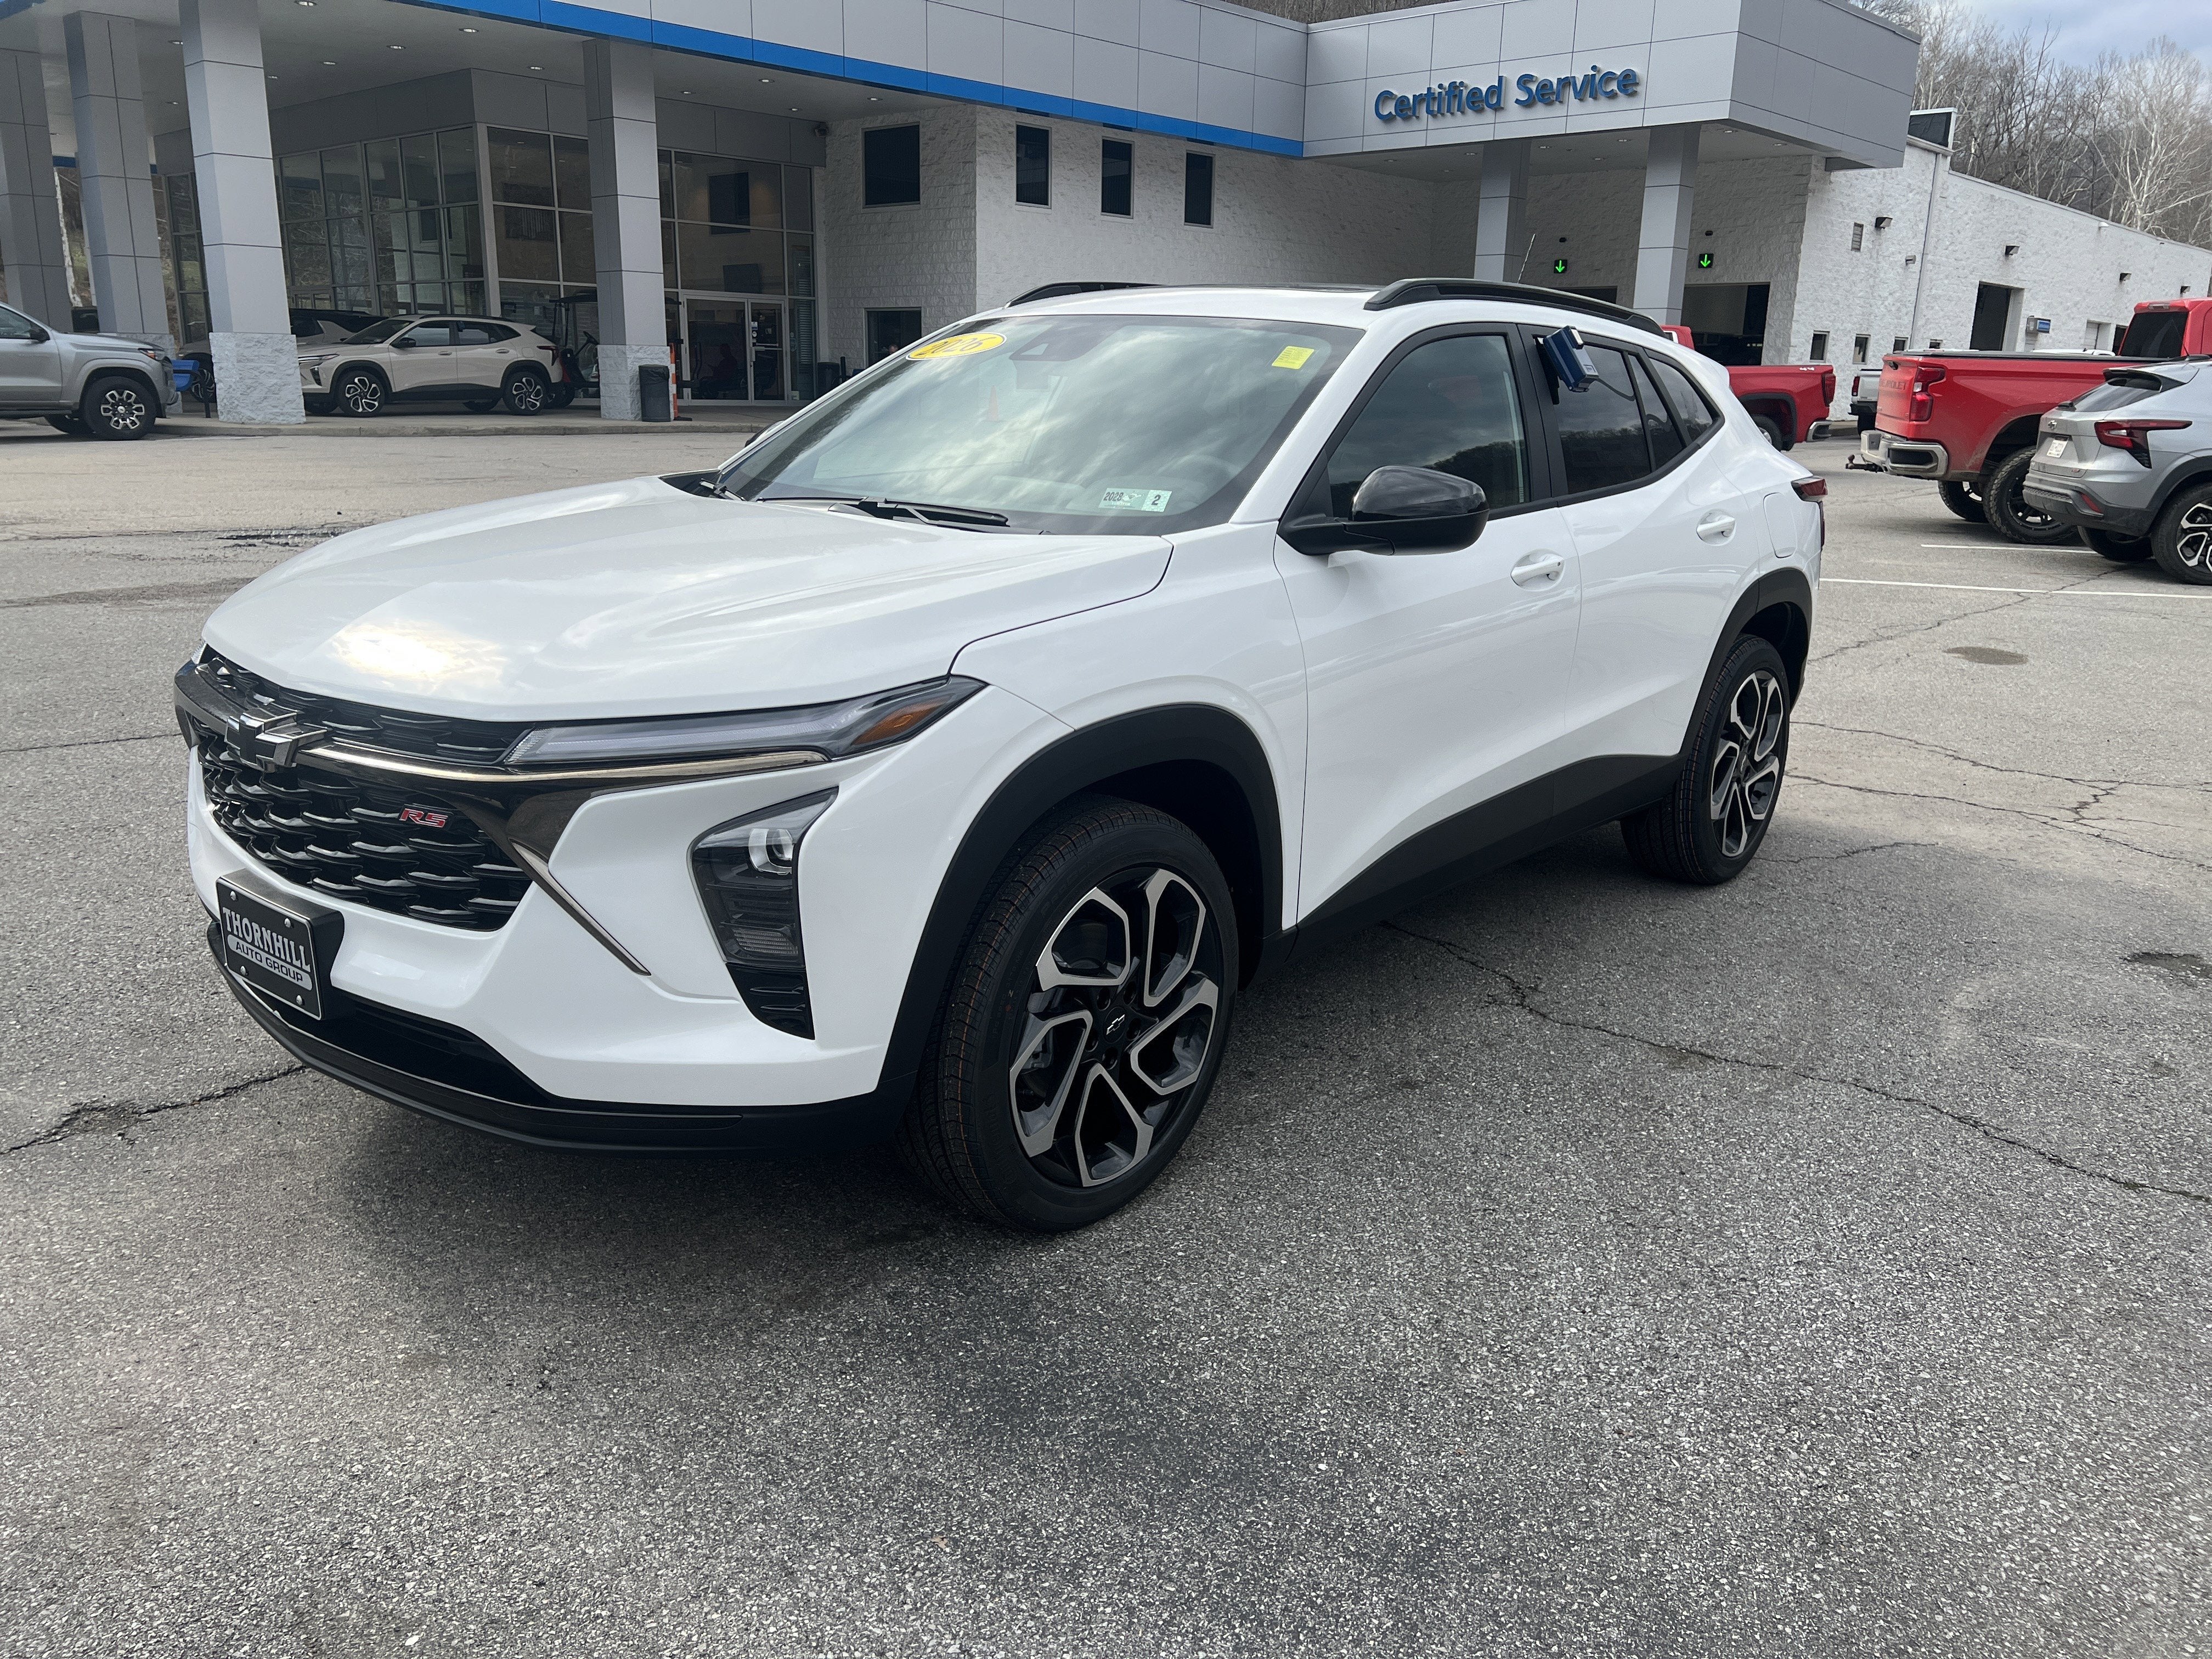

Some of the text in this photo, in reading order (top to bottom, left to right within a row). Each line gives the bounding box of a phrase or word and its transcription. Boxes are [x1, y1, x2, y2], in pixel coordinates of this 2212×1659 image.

[1374, 64, 1640, 121] Certified Service
[1103, 492, 1161, 506] 2028 2
[399, 808, 449, 828] RS
[222, 907, 311, 972] THORNHILL
[235, 941, 303, 982] AUTO GROUP
